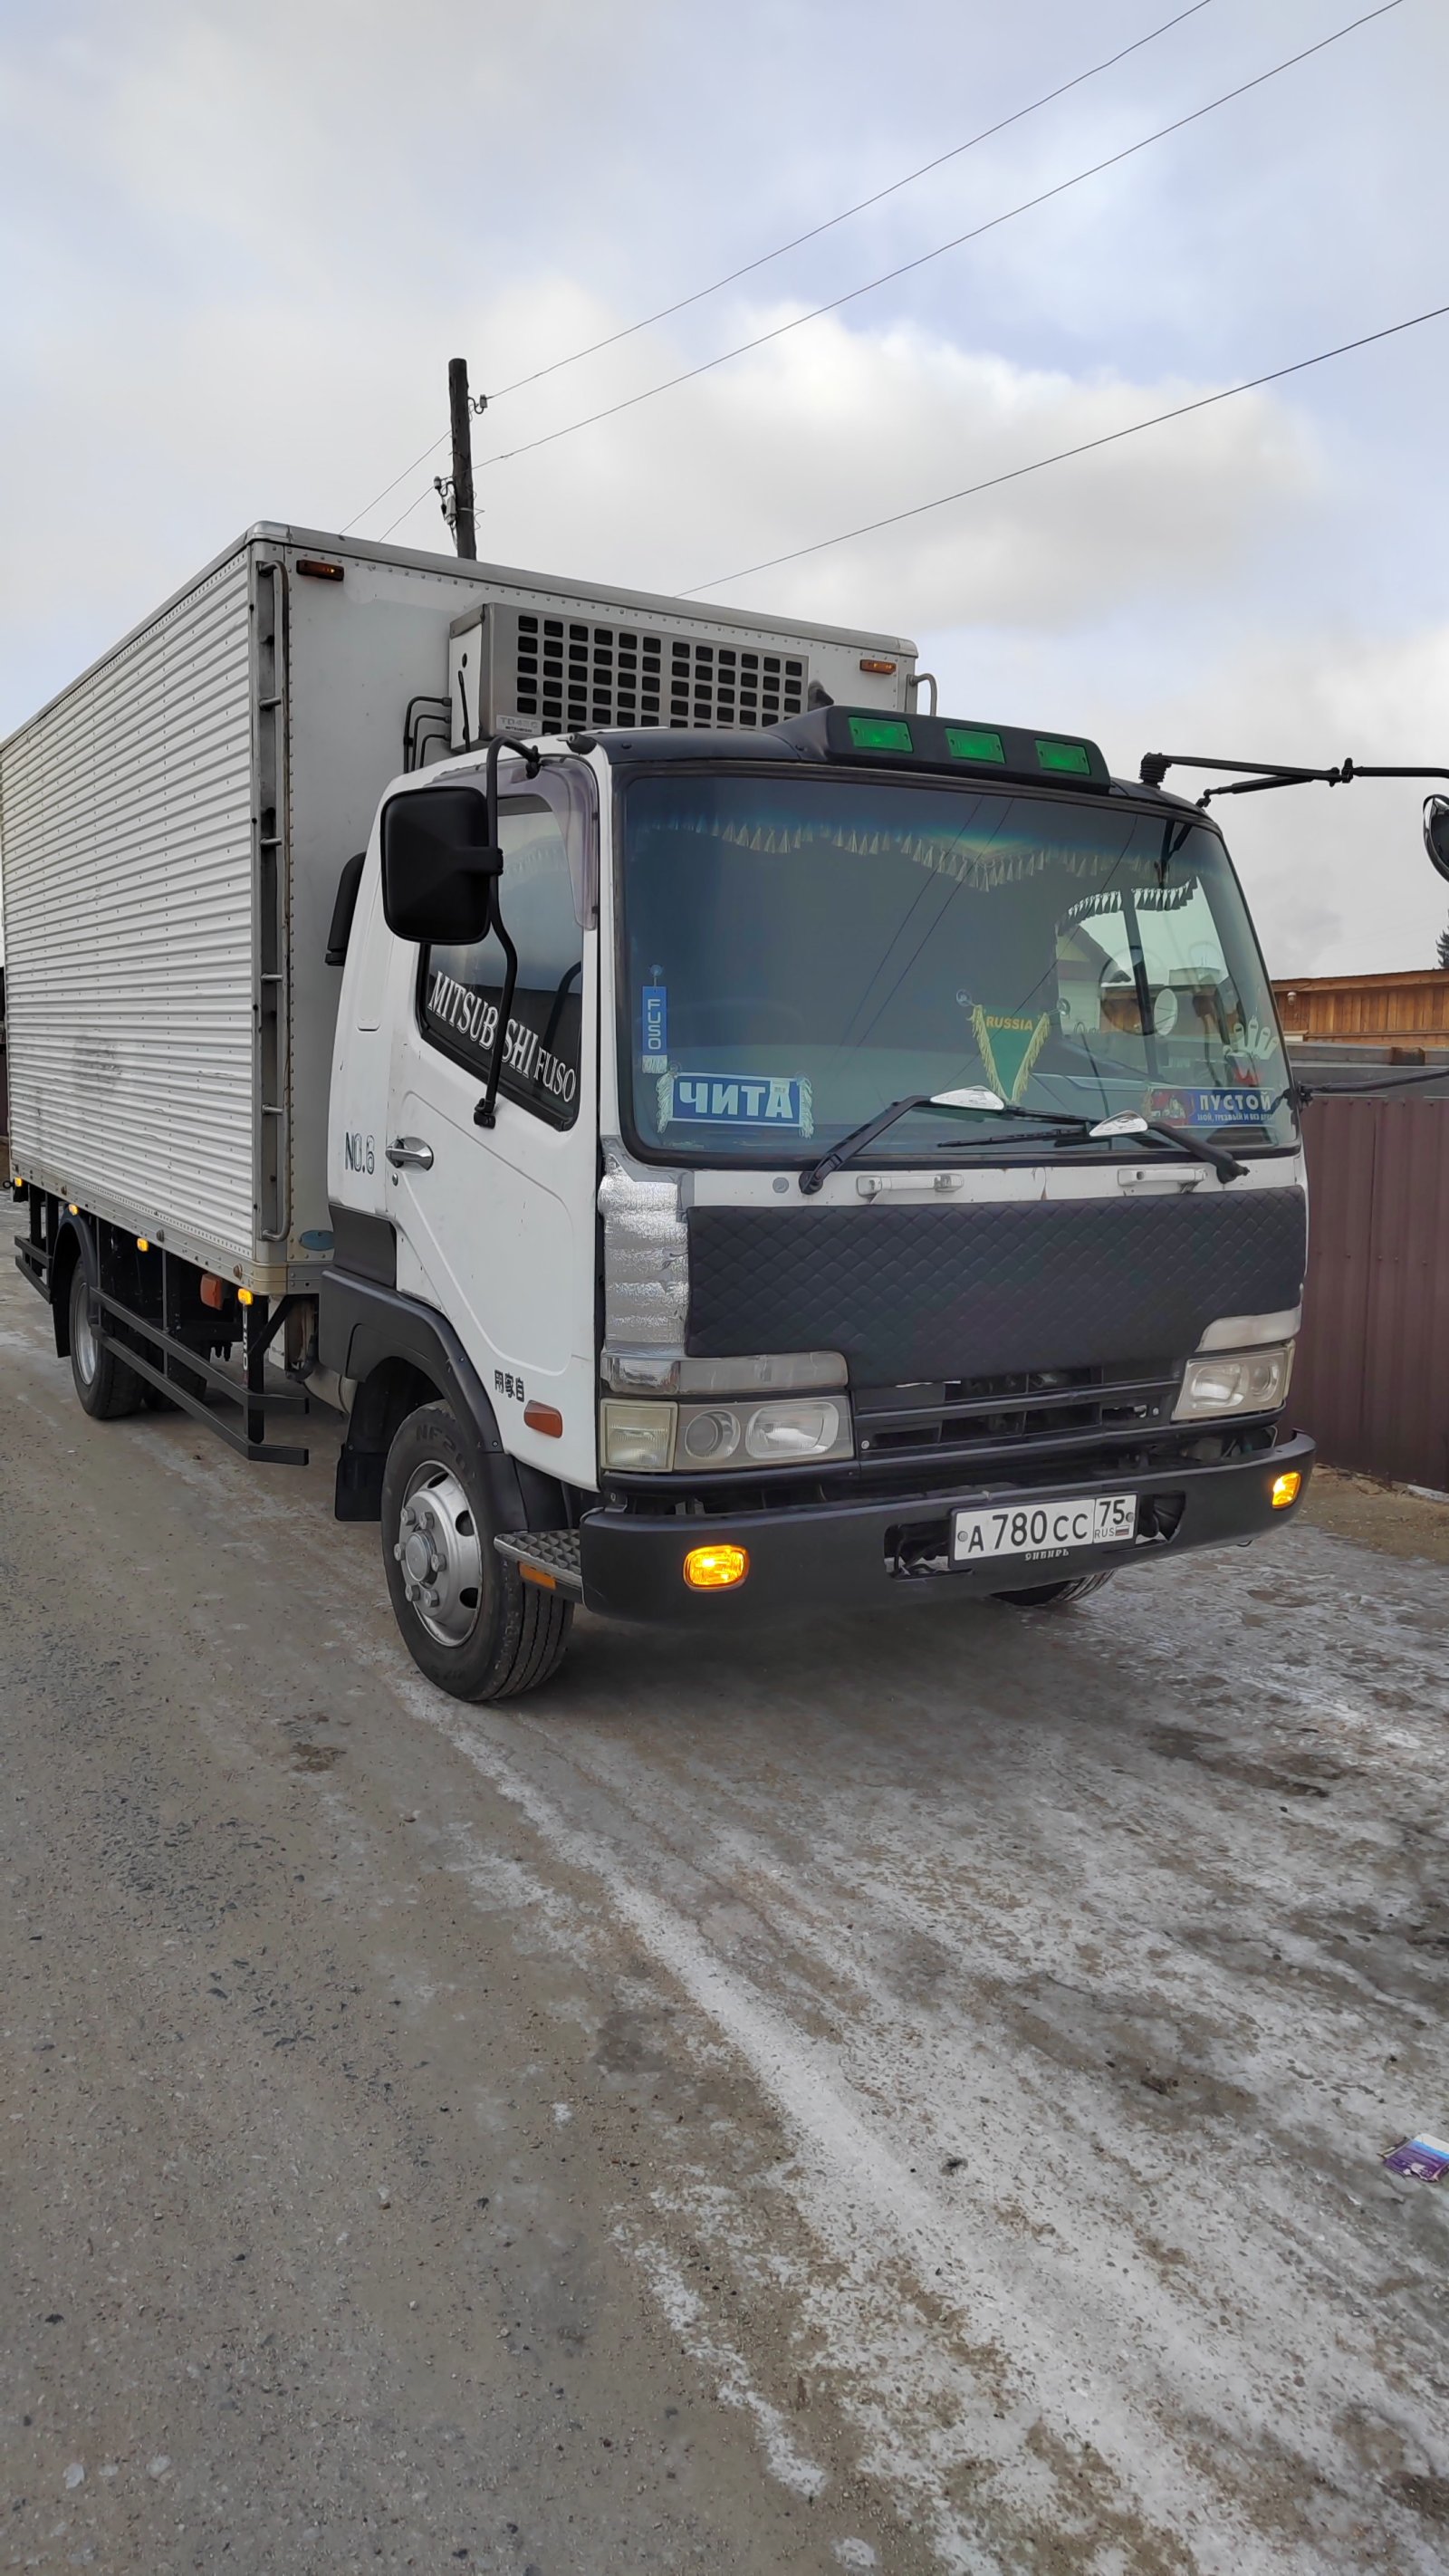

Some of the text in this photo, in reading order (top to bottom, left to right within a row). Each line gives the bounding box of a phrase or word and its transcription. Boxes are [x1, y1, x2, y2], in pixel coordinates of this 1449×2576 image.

[427, 970, 577, 1102] MITSUBSHI FUSO
[647, 998, 662, 1050] FUSO
[985, 1015, 1033, 1030] RUSSIA
[679, 1081, 793, 1119] ЧИТА
[1200, 1091, 1271, 1111] ПУСТОЙ
[1099, 1499, 1126, 1527] 75
[1095, 1527, 1115, 1538] RUS
